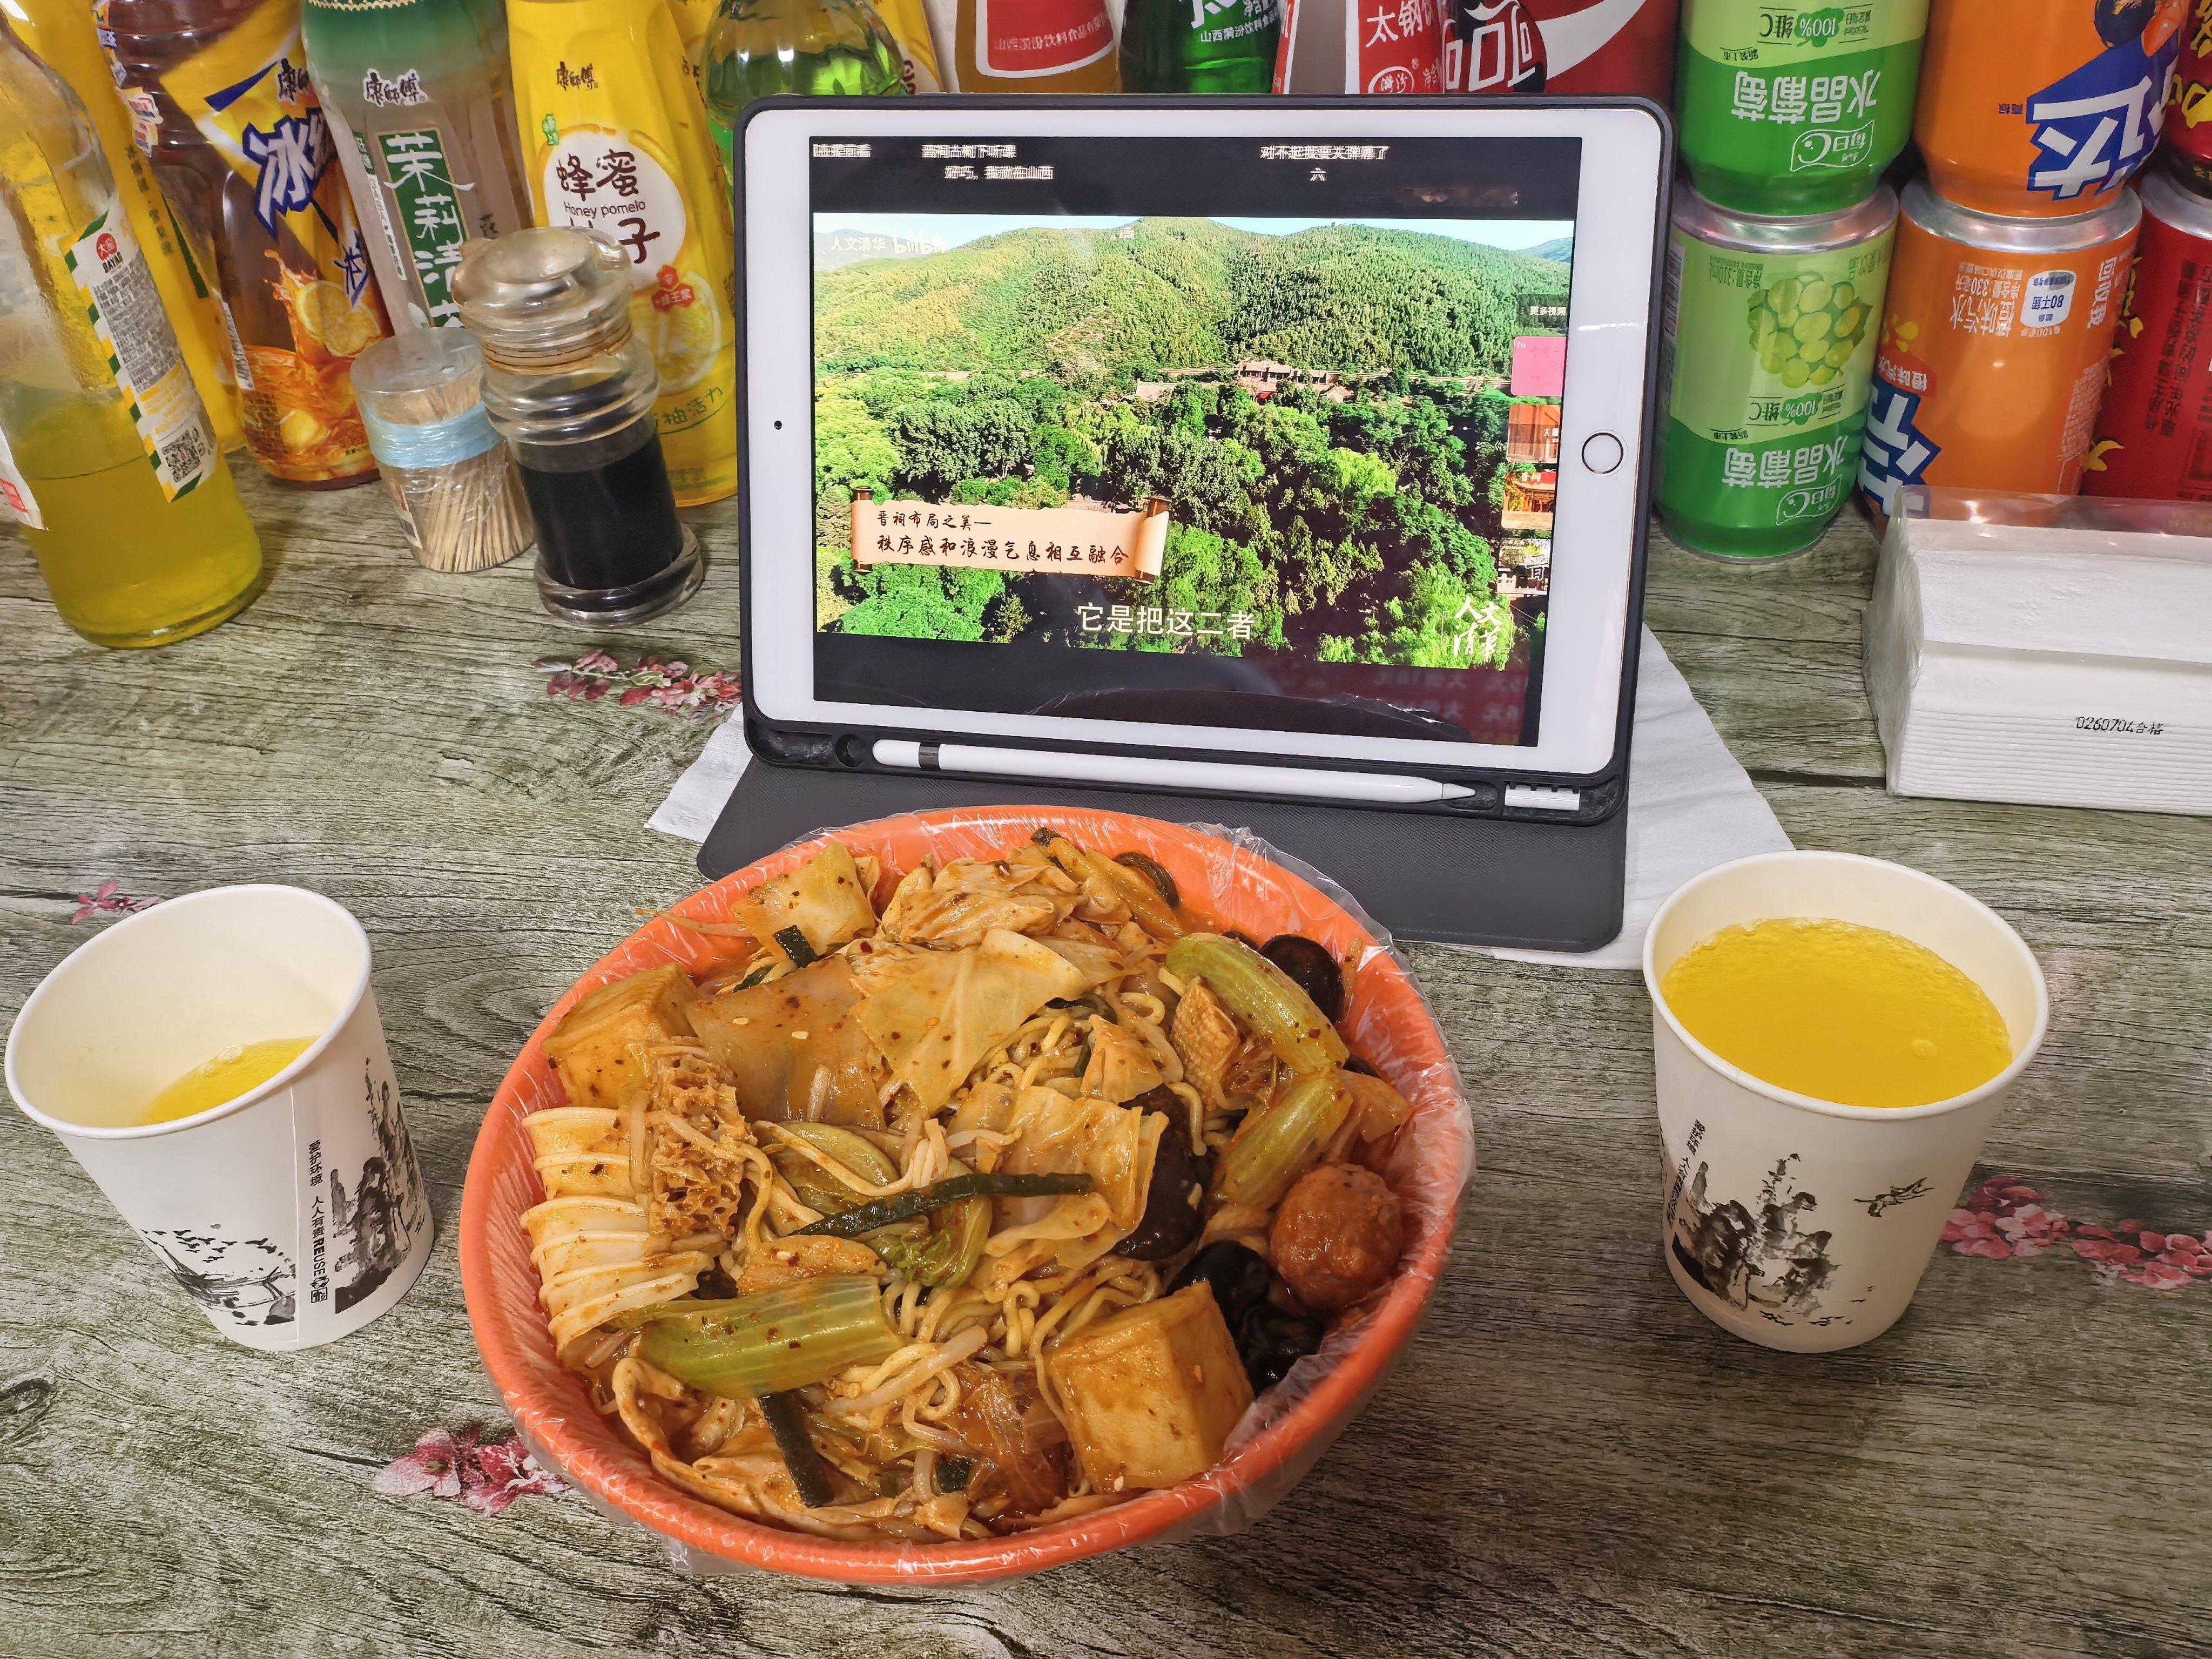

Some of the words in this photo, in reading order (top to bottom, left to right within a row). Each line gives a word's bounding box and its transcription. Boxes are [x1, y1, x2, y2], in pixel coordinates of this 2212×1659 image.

[1366, 0, 1432, 47] 太钢
[1800, 18, 1836, 37] 100%
[1731, 70, 1881, 125] 水晶葡萄
[1260, 145, 1390, 160] 对不起我要关弹幕了
[247, 114, 326, 230] 冰
[556, 149, 639, 201] 蜂蜜
[1310, 167, 1327, 181] 六
[564, 201, 597, 219] Honey
[601, 199, 646, 218] pomelo
[830, 236, 887, 252] 人文清华
[1529, 306, 1567, 316] 更多视频
[1950, 294, 2015, 338] 橙味汽水
[1722, 435, 1847, 488] 水晶葡萄
[876, 535, 1129, 565] 秩序感和浪漫气息相互融合
[1078, 602, 1256, 639] 它是把这二者
[313, 1238, 326, 1277] REUSE
